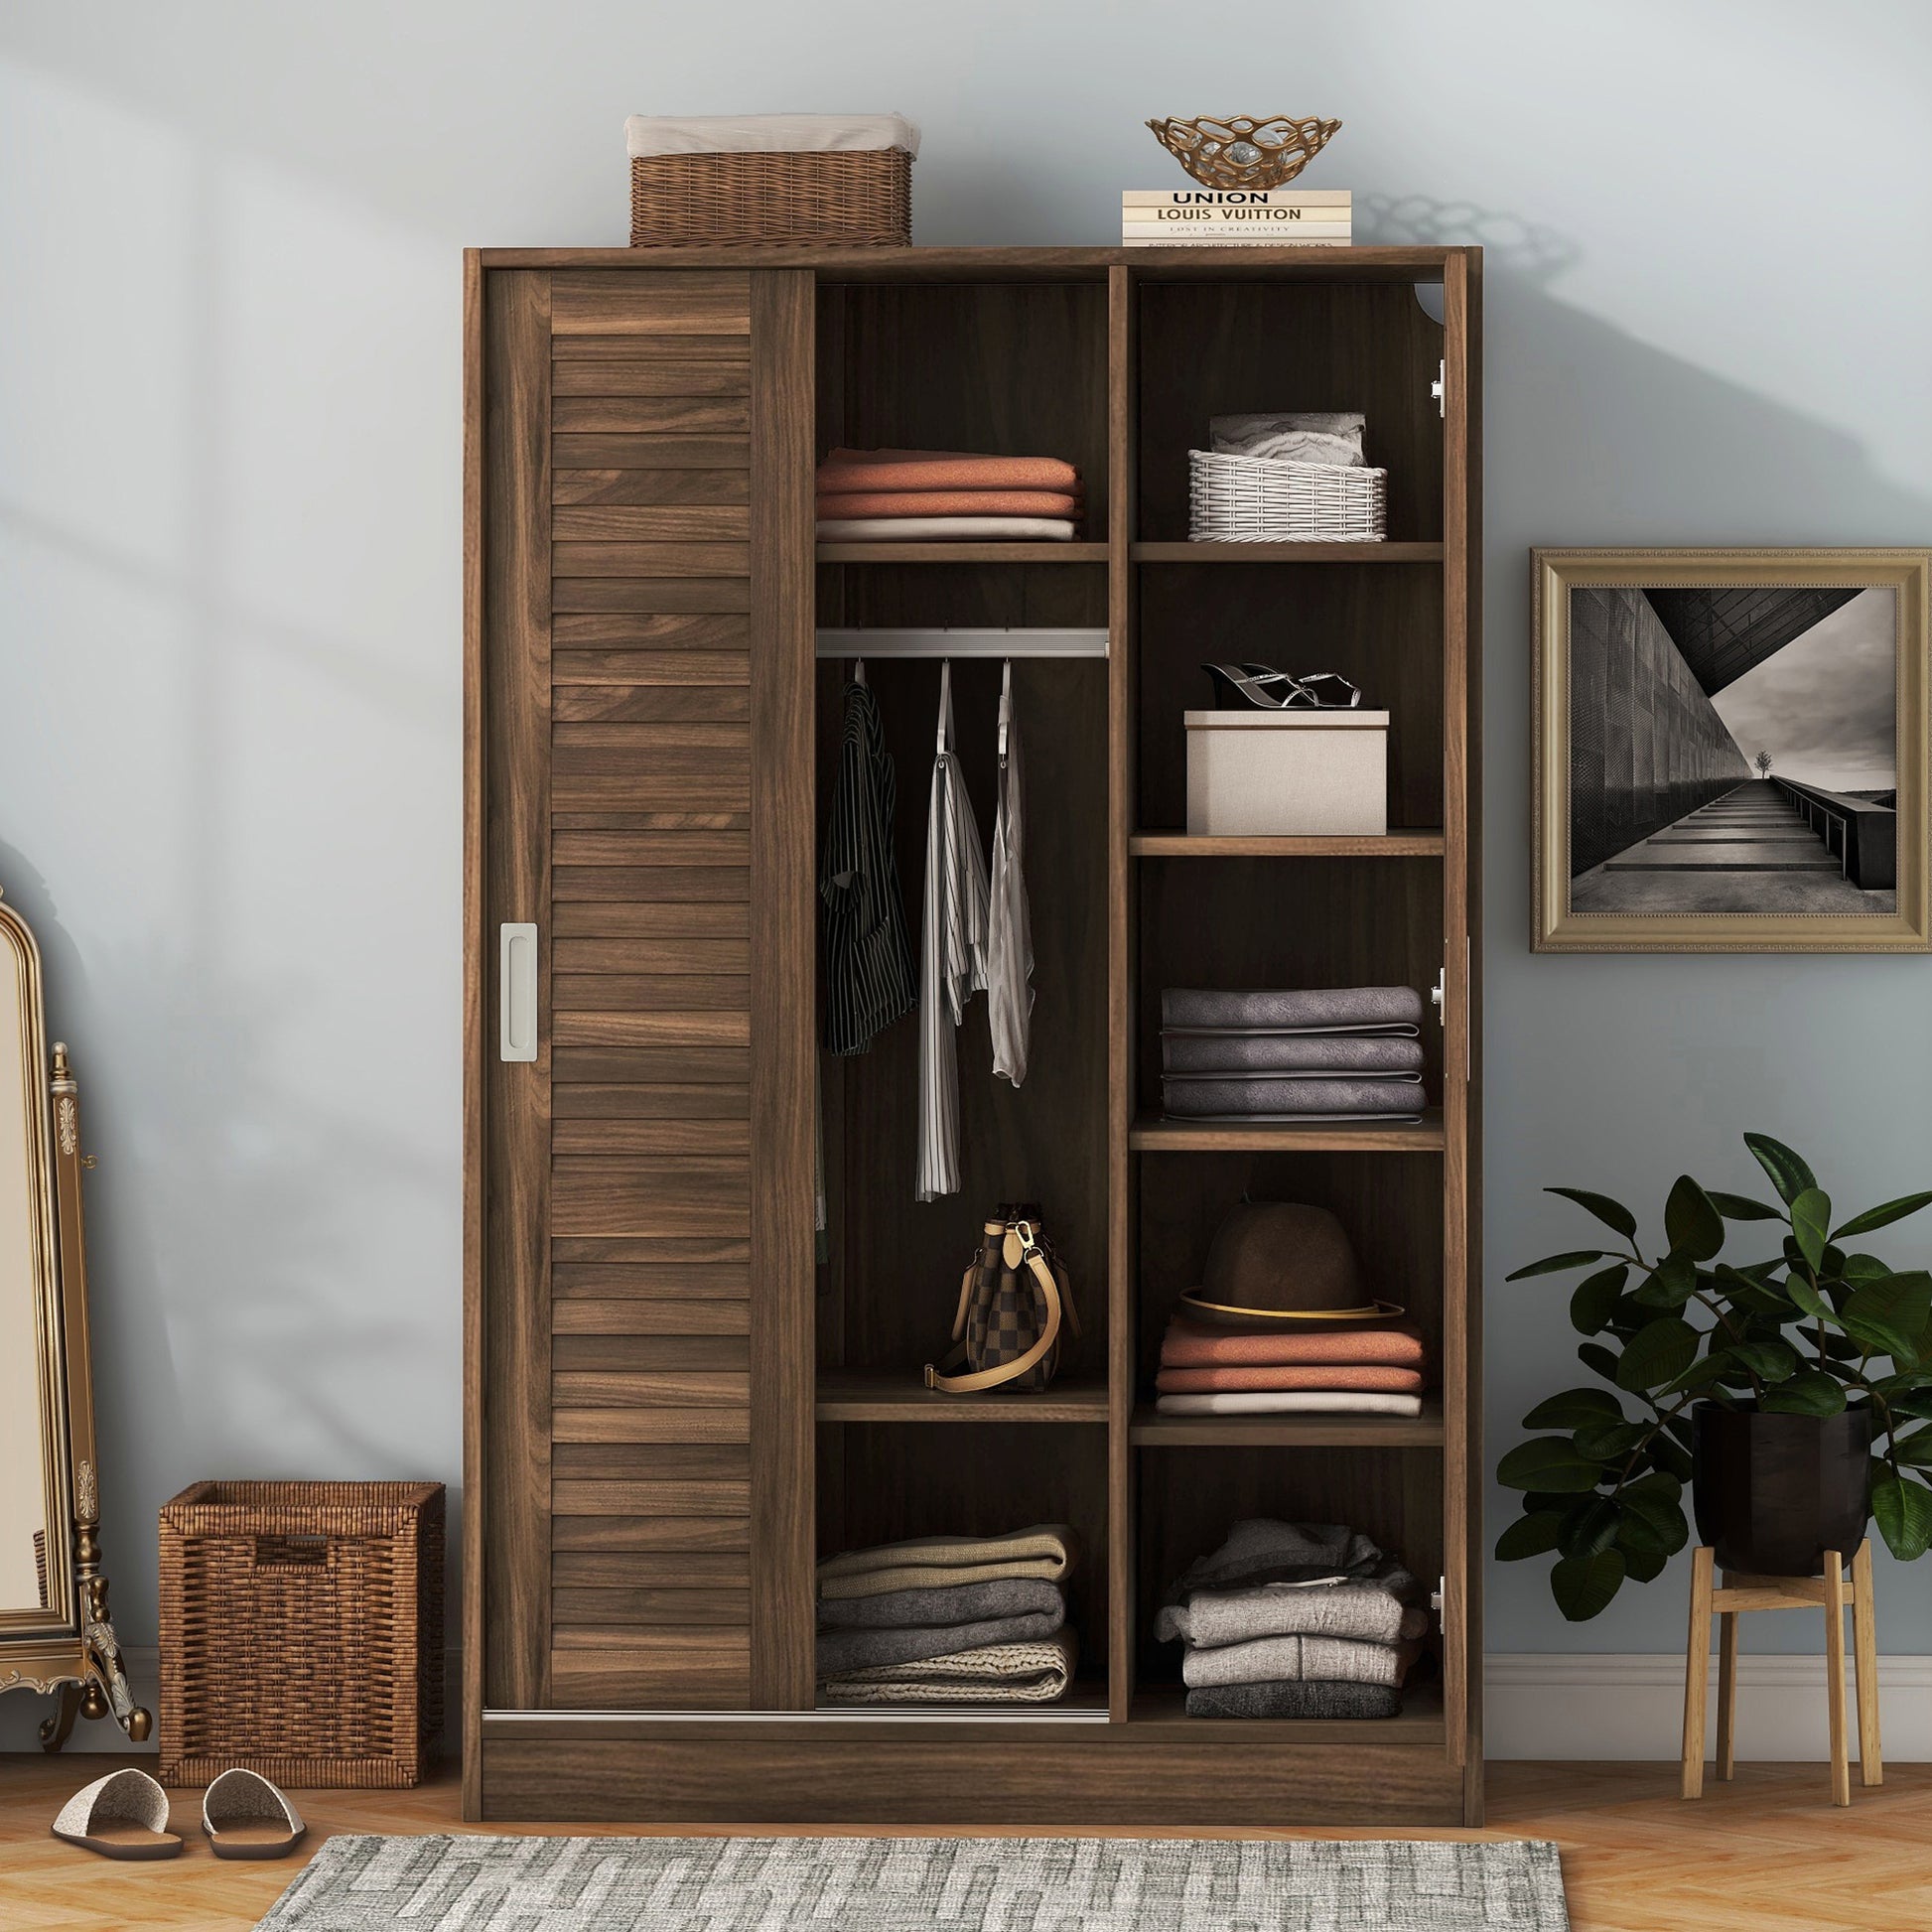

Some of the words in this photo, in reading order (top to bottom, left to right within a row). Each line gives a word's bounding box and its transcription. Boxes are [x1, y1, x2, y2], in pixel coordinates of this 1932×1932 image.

[1173, 193, 1268, 204] UNION
[1158, 208, 1211, 219] LOUIS
[1222, 208, 1301, 219] VUITTON
